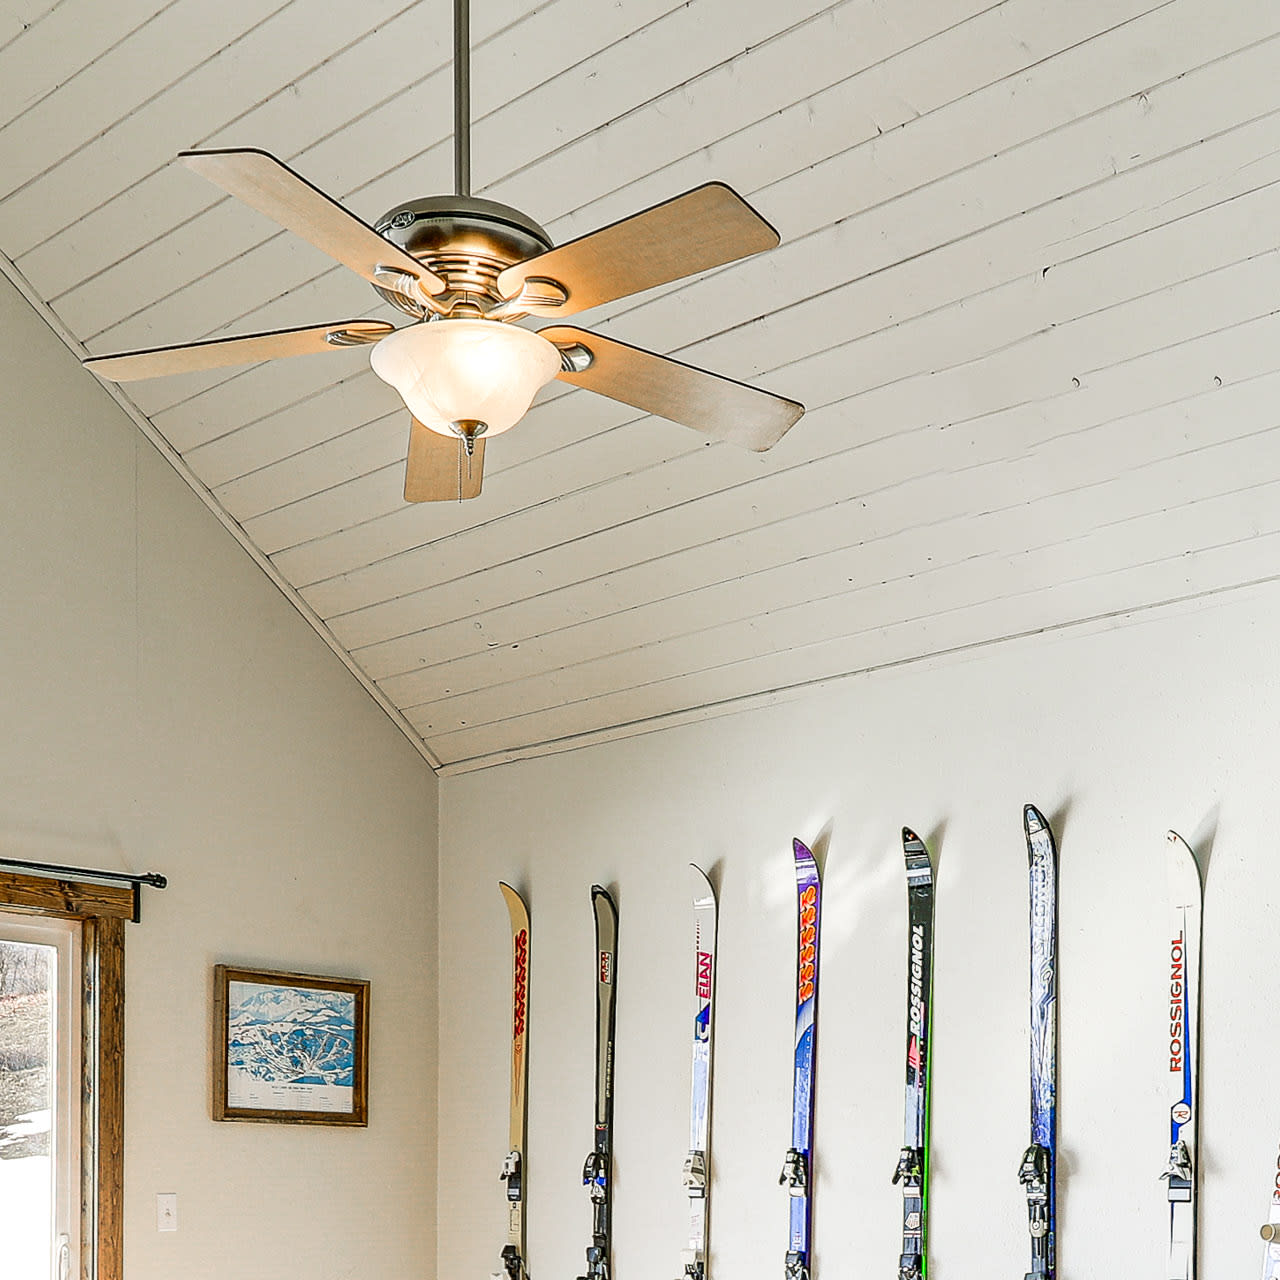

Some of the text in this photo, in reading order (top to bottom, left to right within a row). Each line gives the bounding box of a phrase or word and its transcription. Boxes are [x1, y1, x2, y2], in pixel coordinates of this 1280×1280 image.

[697, 950, 712, 1000] ELAN
[910, 925, 924, 1037] ROSSIGNOL
[1169, 930, 1183, 1072] ROSSIGNOL
